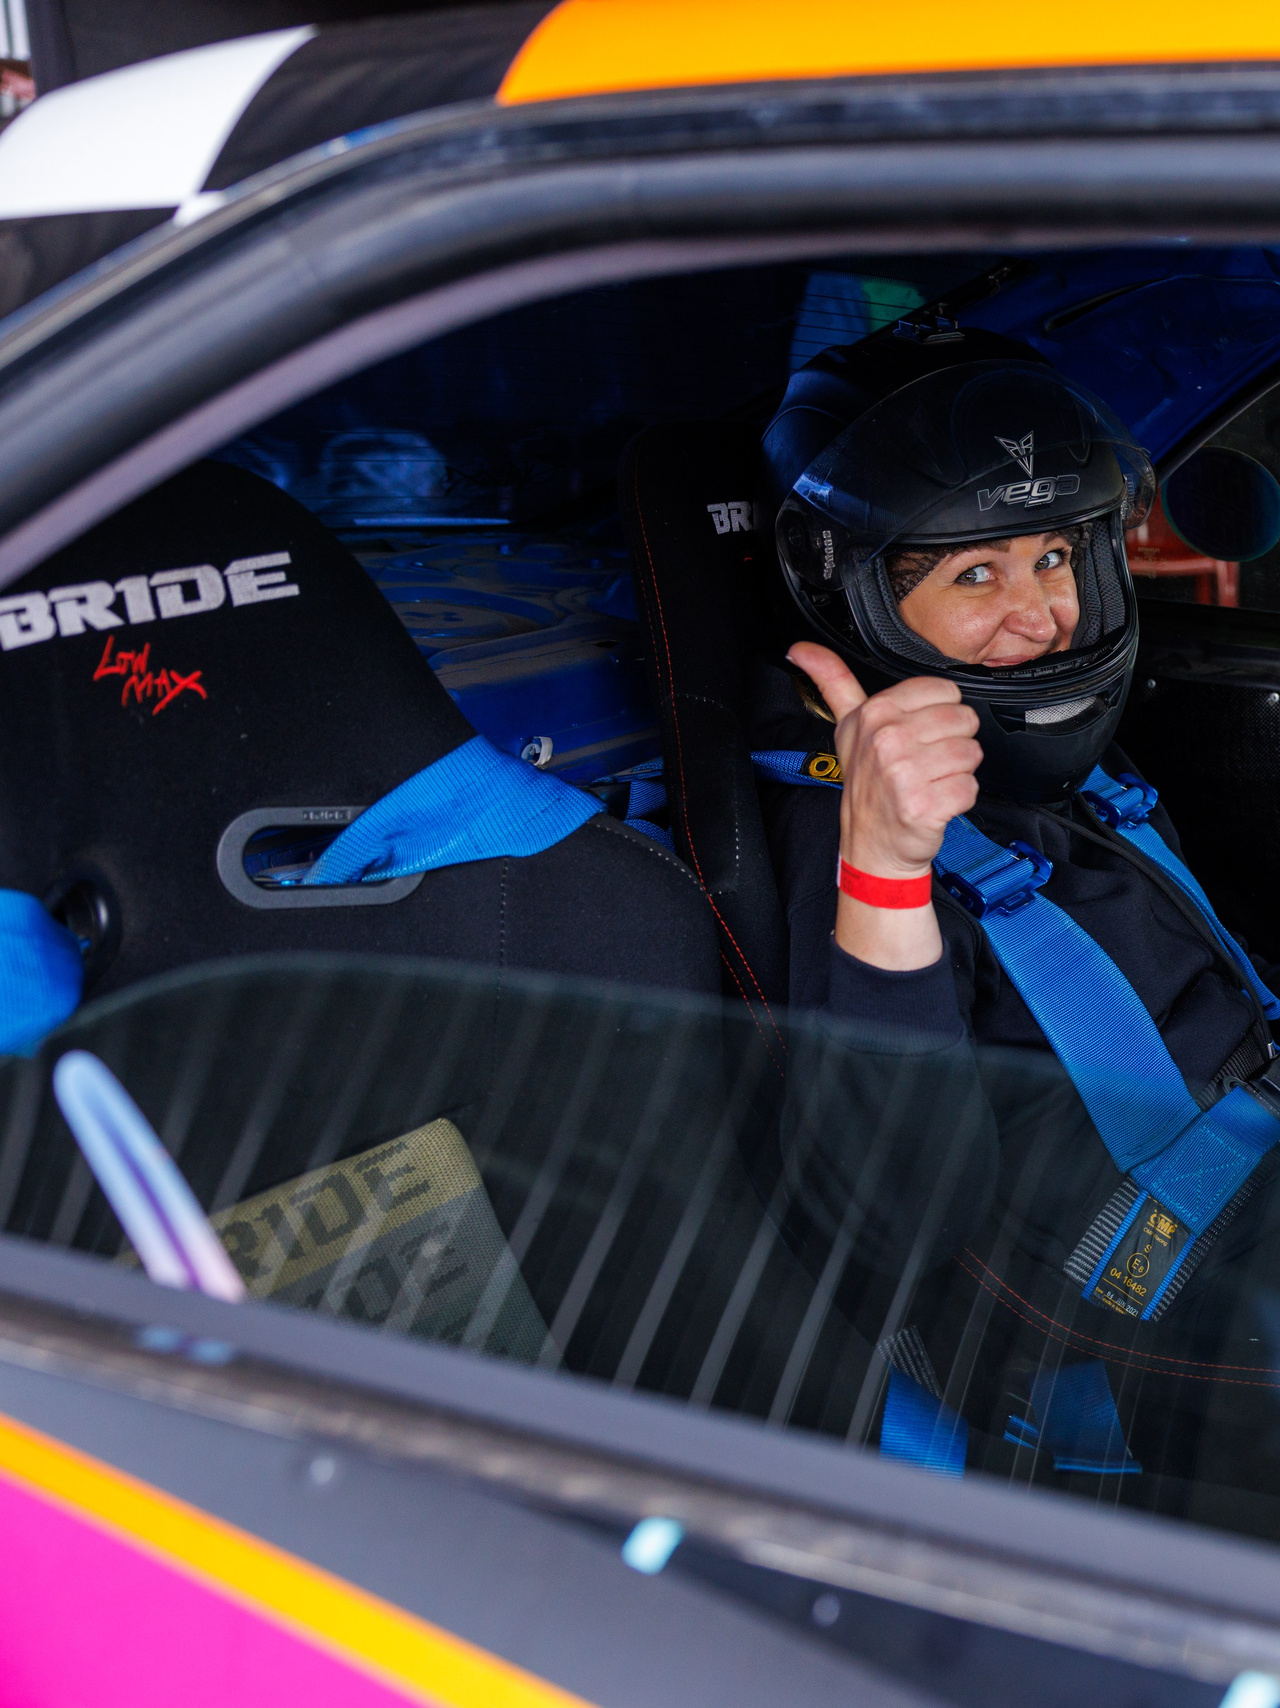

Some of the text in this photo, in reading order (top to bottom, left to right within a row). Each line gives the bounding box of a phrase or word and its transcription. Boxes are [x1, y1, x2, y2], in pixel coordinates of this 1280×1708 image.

[1148, 1210, 1178, 1239] OMP
[1144, 1244, 1152, 1253] S
[1110, 1267, 1147, 1297] 04 16482
